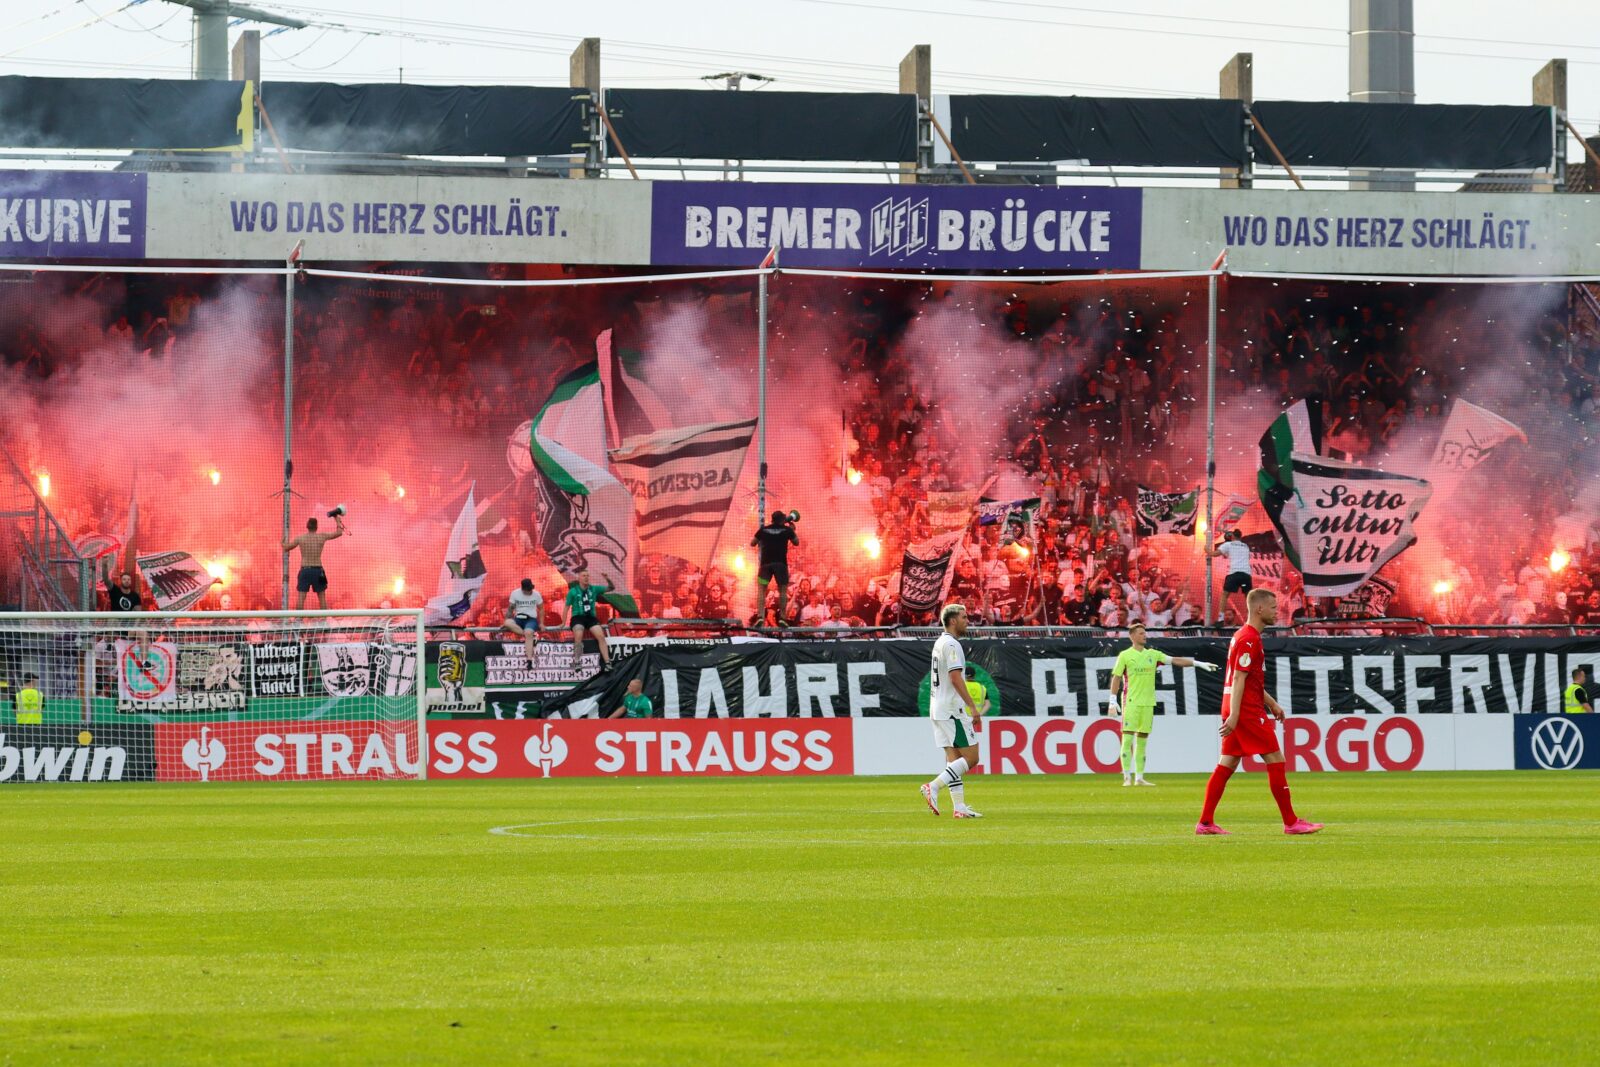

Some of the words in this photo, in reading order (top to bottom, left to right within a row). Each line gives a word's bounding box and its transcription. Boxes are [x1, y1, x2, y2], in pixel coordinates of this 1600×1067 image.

[0, 198, 132, 244] KURVE
[230, 200, 278, 232] WO
[286, 201, 345, 233] DAS
[353, 203, 426, 235] HERZ
[432, 198, 568, 238] SCHLÄGT.
[685, 205, 862, 250] BREMER
[938, 198, 1111, 252] BRÜCKE
[1224, 215, 1268, 247] WO
[1275, 216, 1329, 248] DAS
[1337, 217, 1404, 249] HERZ
[1411, 212, 1537, 250] SCHLÄGT.
[1315, 485, 1406, 509] Sotto
[255, 643, 299, 658] ultras
[261, 676, 295, 694] nord
[486, 670, 513, 684] ALS
[426, 702, 482, 715] poebel
[0, 730, 127, 781] bwin
[254, 731, 498, 776] STRAUSS
[595, 730, 834, 772] STRAUSS
